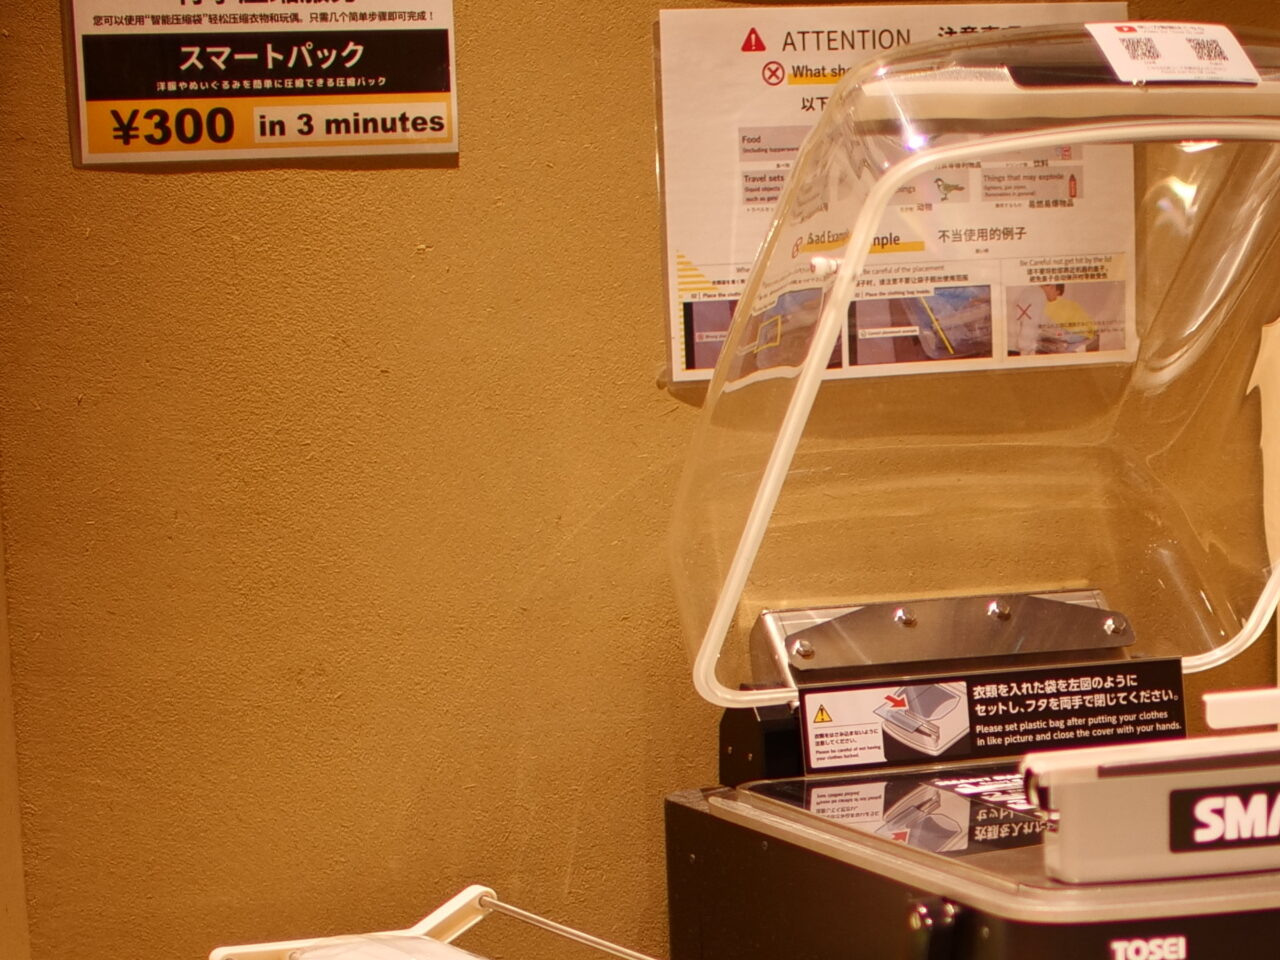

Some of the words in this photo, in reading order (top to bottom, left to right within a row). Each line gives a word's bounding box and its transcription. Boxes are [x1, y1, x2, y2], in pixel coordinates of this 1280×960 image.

[782, 28, 911, 51] ATTENTION
[178, 41, 366, 71] スマートパック
[792, 66, 828, 78] What
[110, 107, 235, 146] ¥300
[258, 115, 286, 138] in
[296, 113, 315, 136] 3
[324, 110, 445, 135] minutes
[742, 135, 761, 144] Food
[744, 174, 767, 183] Travel
[769, 174, 784, 182] sets
[938, 226, 1027, 243] 不当使用的例子
[973, 674, 1138, 700] 衣類を入れた袋を左図のように
[975, 689, 1179, 717] セットし、フタを両手で閉じてください。
[975, 723, 1004, 734] Please
[1004, 722, 1018, 732] set
[1019, 720, 1048, 731] plastic
[1049, 717, 1065, 729] bag
[1066, 716, 1086, 727] after
[1088, 713, 1117, 726] putting
[1119, 713, 1137, 723] your
[1139, 711, 1169, 721] clothes
[977, 737, 986, 746] in
[986, 735, 1003, 745] like
[1004, 733, 1034, 746] picture
[1035, 732, 1051, 742] and
[1053, 730, 1075, 740] close
[1076, 728, 1090, 738] the
[1092, 727, 1114, 737] cover
[1116, 724, 1135, 734] with
[1136, 724, 1154, 735] your
[1155, 721, 1182, 731] hands.
